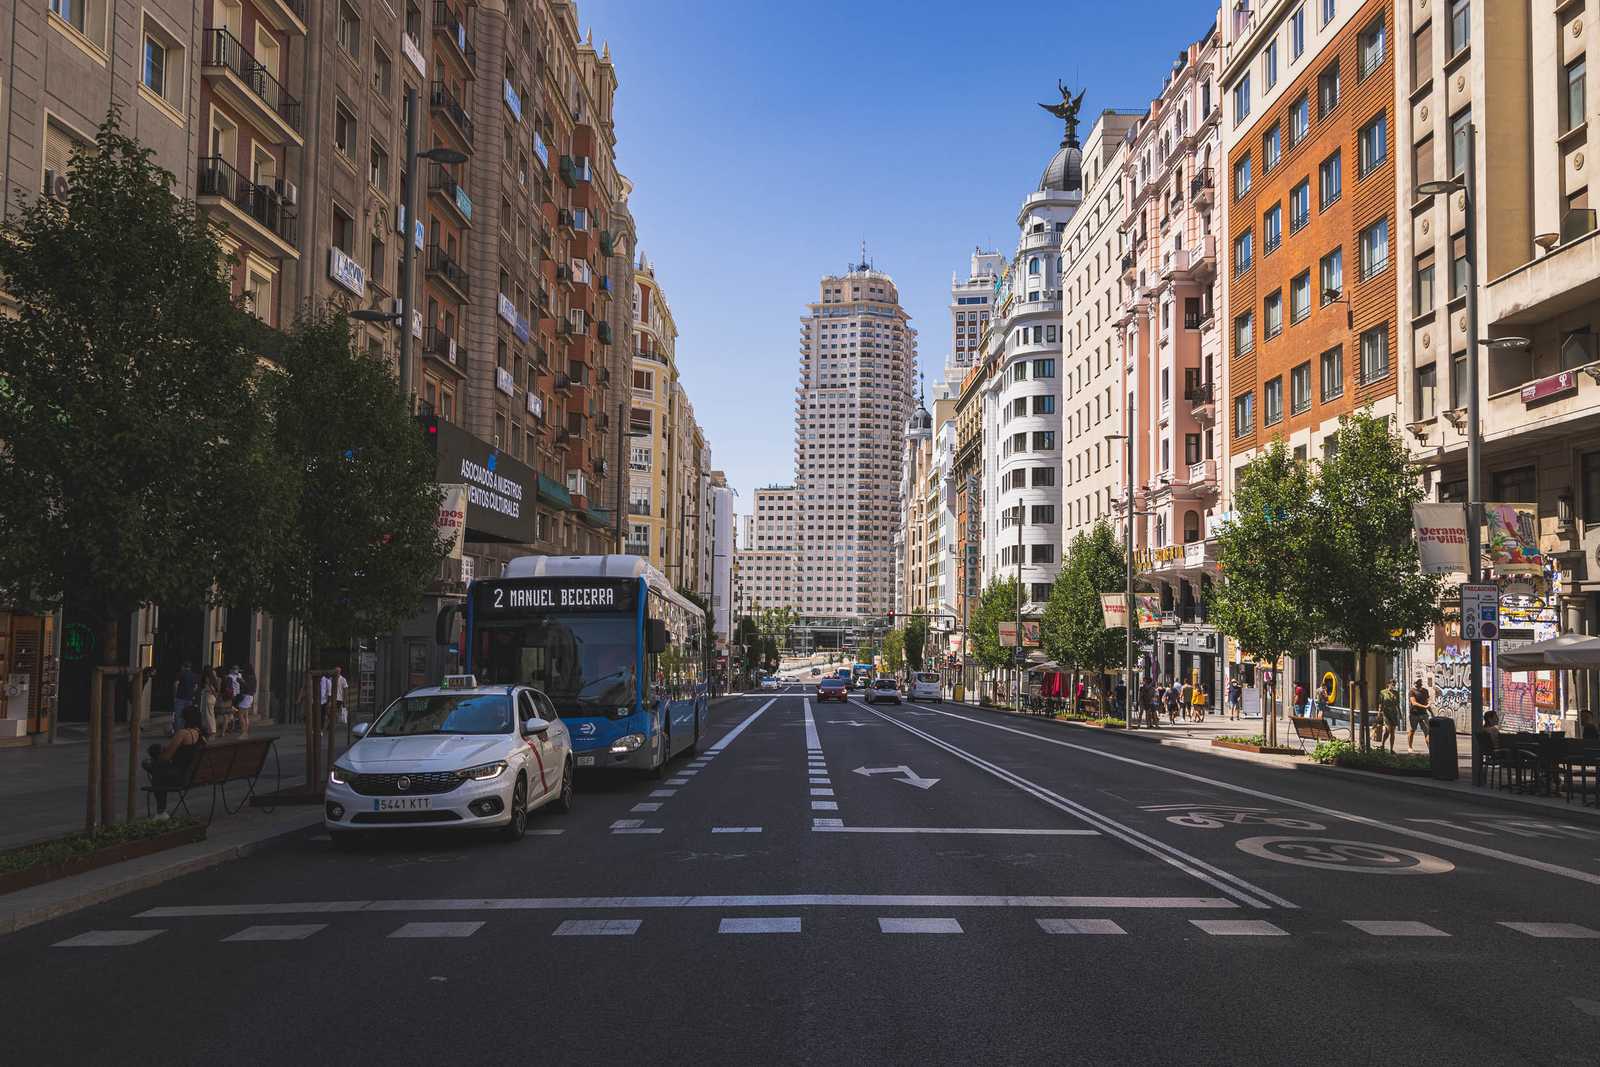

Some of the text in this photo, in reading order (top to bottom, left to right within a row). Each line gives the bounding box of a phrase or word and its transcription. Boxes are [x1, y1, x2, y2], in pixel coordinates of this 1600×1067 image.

[460, 458, 523, 501] ASOCIADOS A NUESTROS
[467, 486, 520, 519] VENTOS CULTURALES
[967, 476, 978, 598] SENATOR HOTEL
[494, 588, 614, 608] 2 MANUEL BECERRA
[381, 798, 430, 810] 5441 KTT
[1277, 842, 1401, 863] 30
